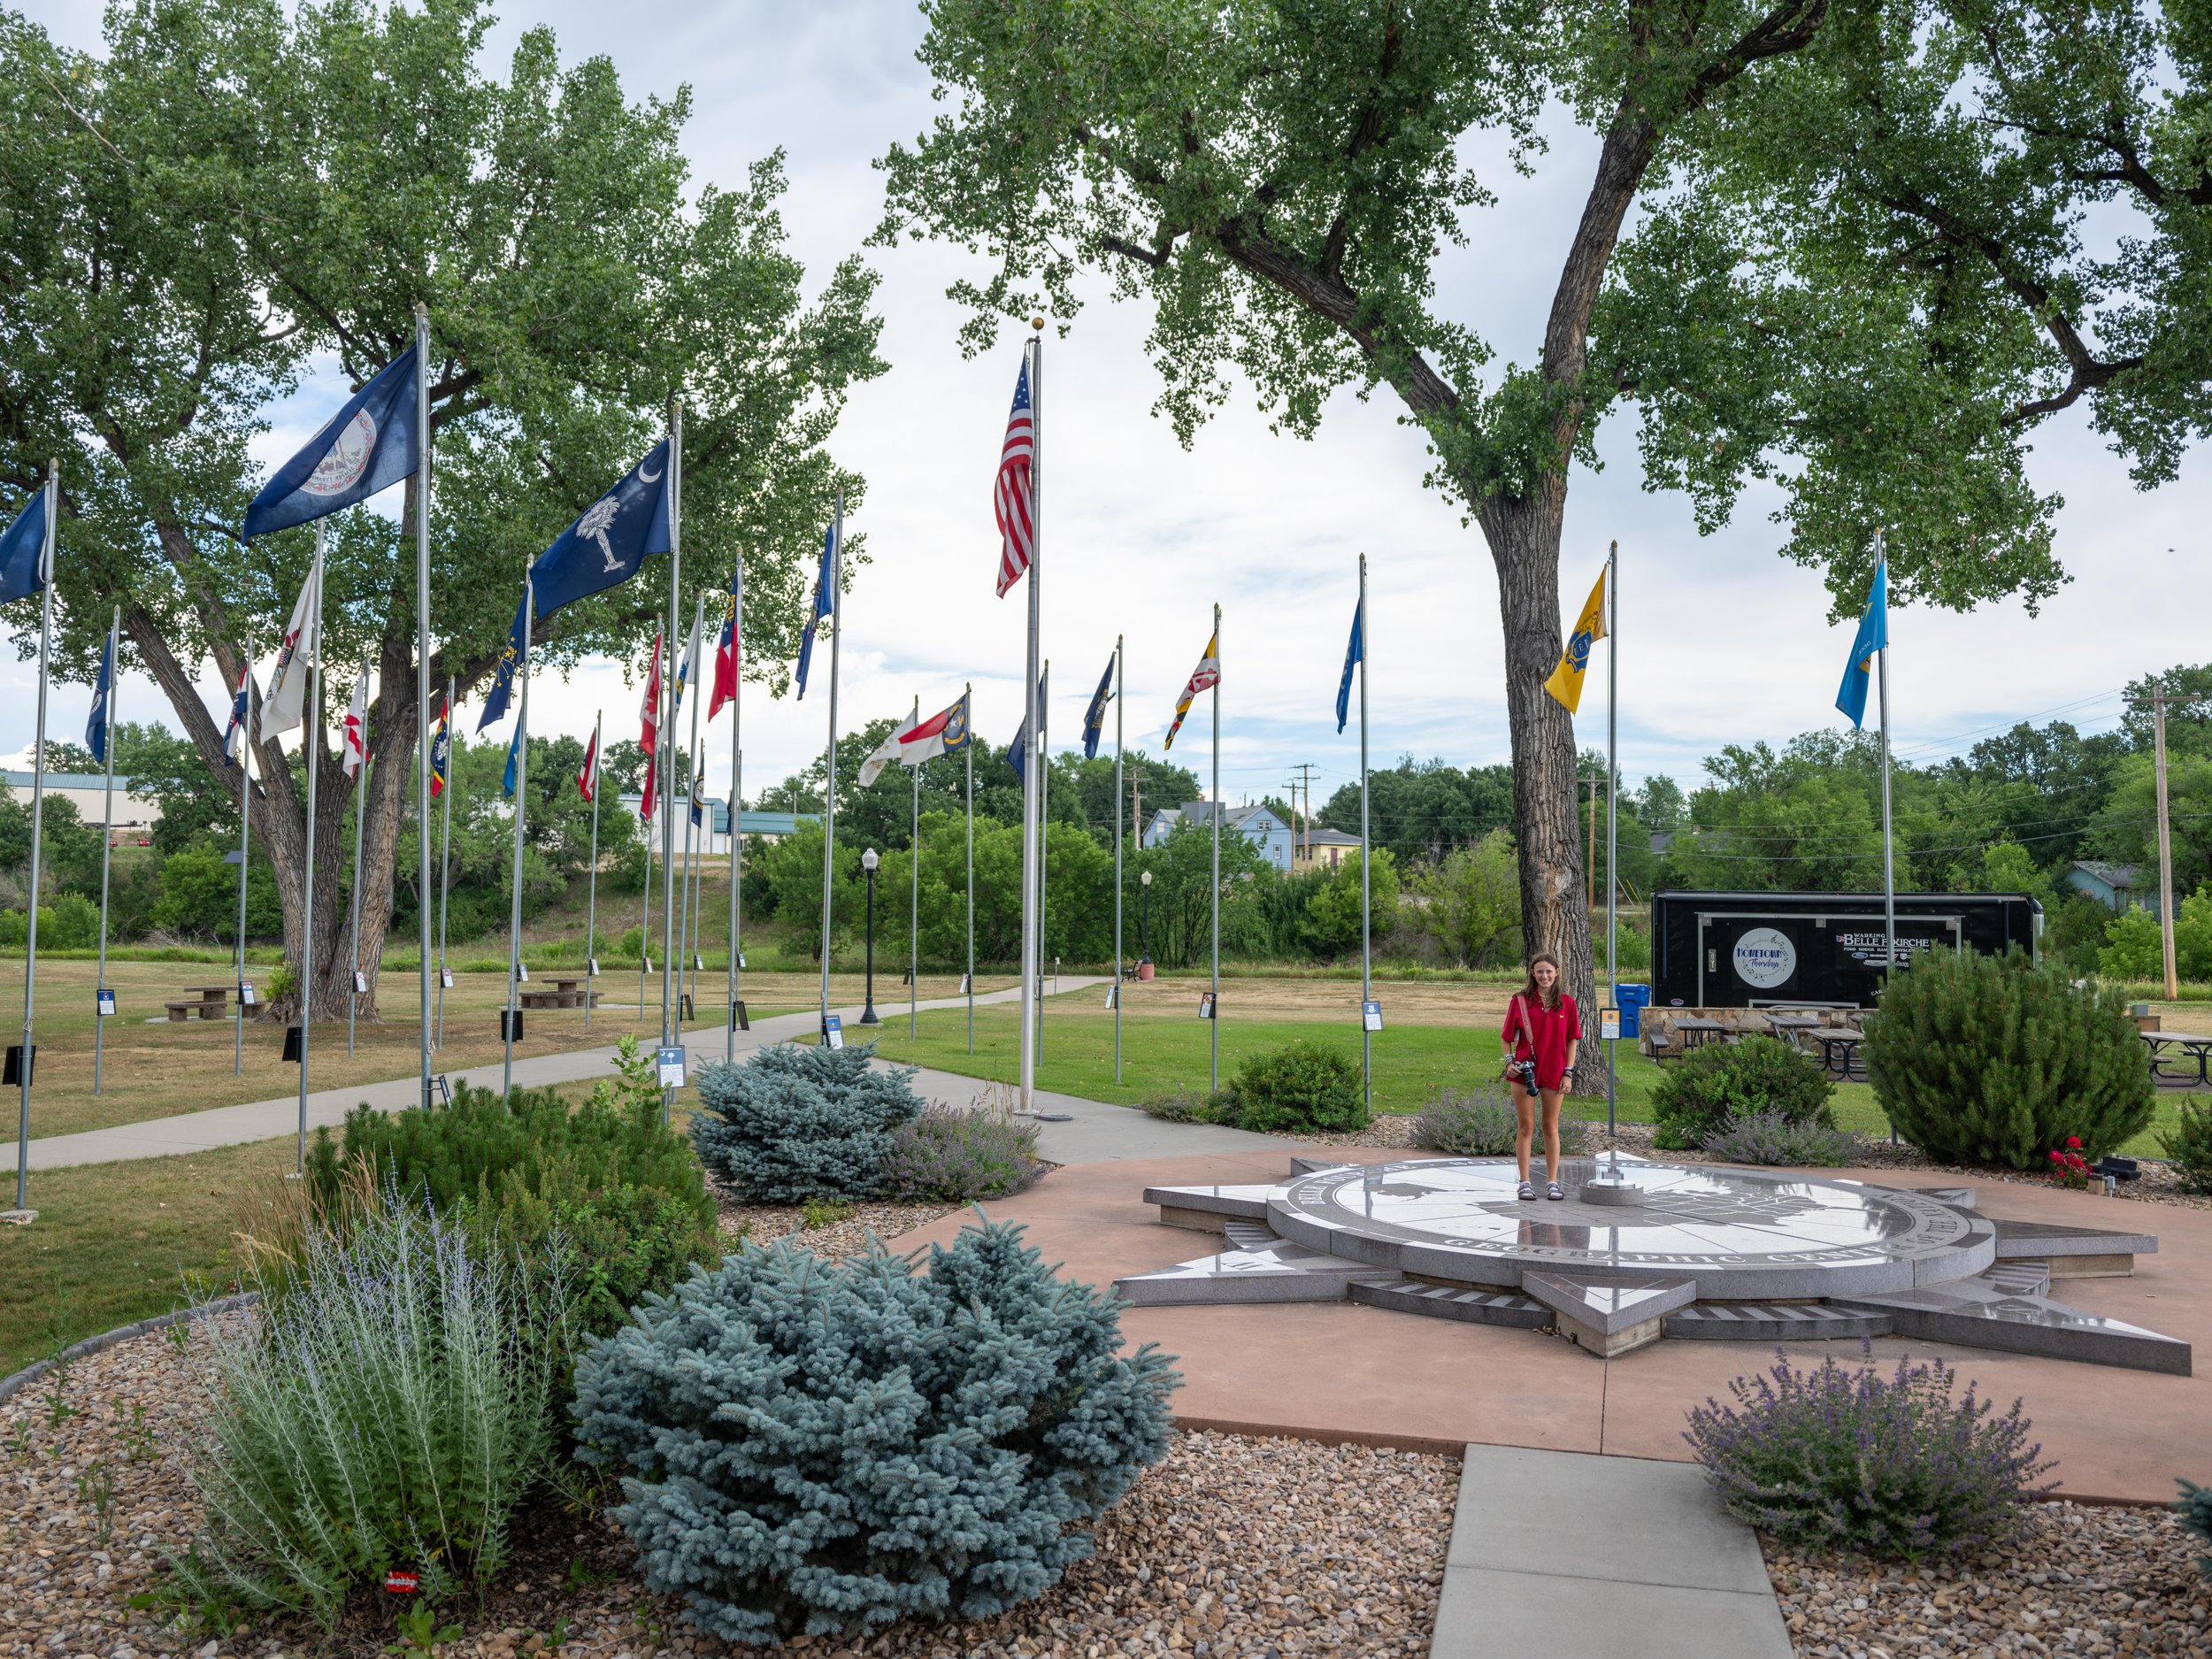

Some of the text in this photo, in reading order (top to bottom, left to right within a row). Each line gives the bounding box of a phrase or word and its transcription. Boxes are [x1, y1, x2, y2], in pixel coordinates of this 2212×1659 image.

[1843, 933, 1879, 946] BELLE
[1737, 948, 1783, 958] HOMETOWN
[1748, 958, 1779, 970] Thursdays
[1444, 1238, 1747, 1264] GEOGRAPHIC
[1925, 1219, 1957, 1234] THE
